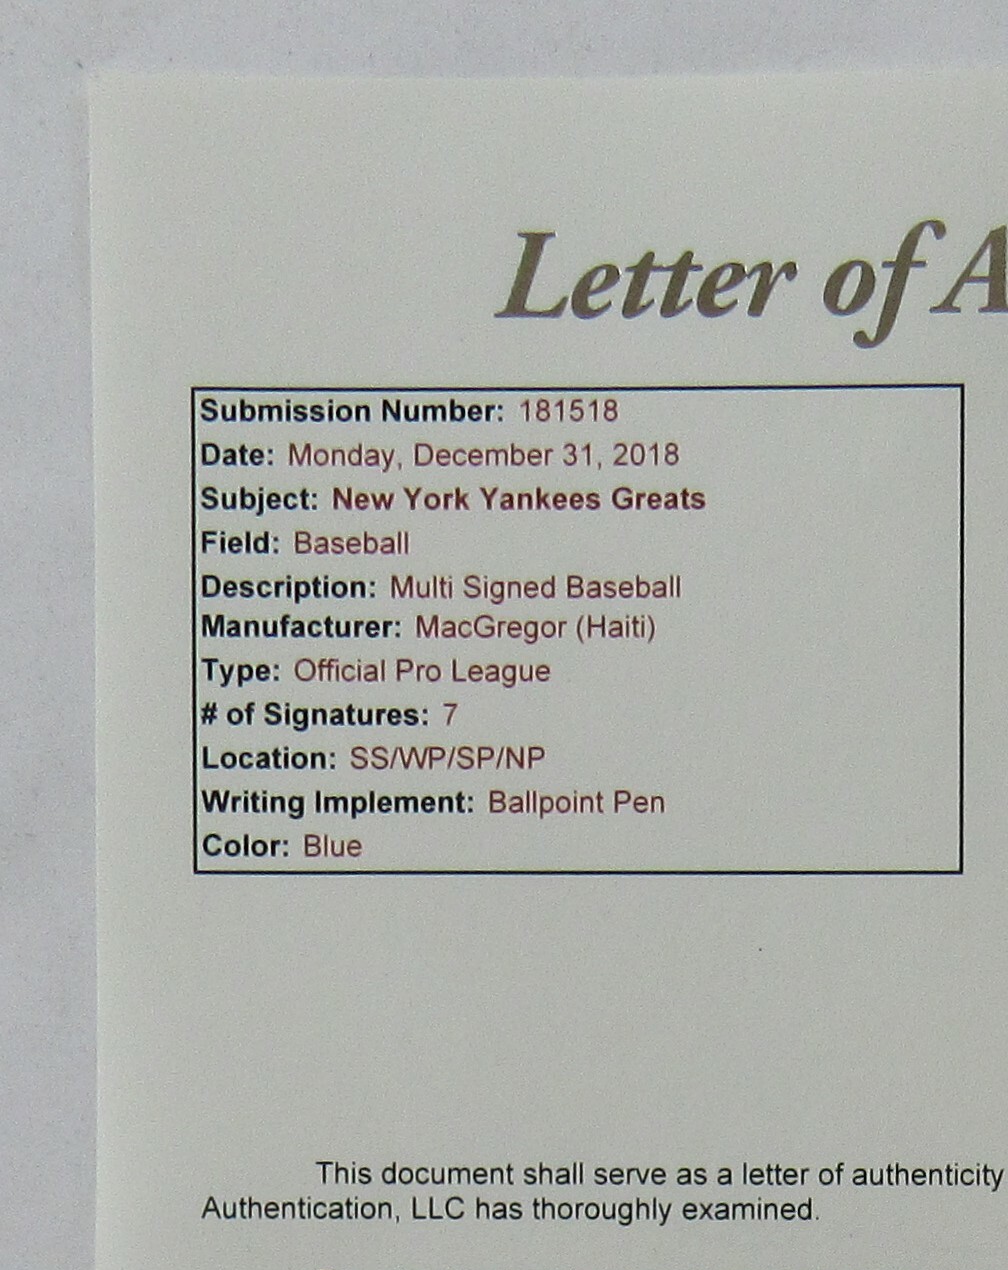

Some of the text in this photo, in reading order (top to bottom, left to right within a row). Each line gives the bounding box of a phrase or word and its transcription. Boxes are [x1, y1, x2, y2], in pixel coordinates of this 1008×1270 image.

[493, 231, 798, 320] Letter
[822, 219, 947, 350] of
[200, 397, 618, 423] Submission Number: 181518
[200, 441, 679, 473] Date: Monday, December 31, 2018
[200, 485, 706, 517] Subject: New York Yankees Greats
[201, 530, 409, 555] Field: Baseball
[201, 574, 681, 605] Description: Multi Signed Baseball
[201, 613, 655, 645] Manufacturer: MacGregor (Haiti)
[200, 657, 551, 689] Type: Official Pro League
[200, 701, 458, 732] # of Signatures: 7
[202, 745, 545, 770] Location: SS/WP/SP/NP
[200, 789, 665, 820] Writing Implement: Ballpoint Pen
[201, 832, 362, 858] Color: Blue
[200, 1195, 819, 1227] Authentication, LLC has thoroughly examined.
